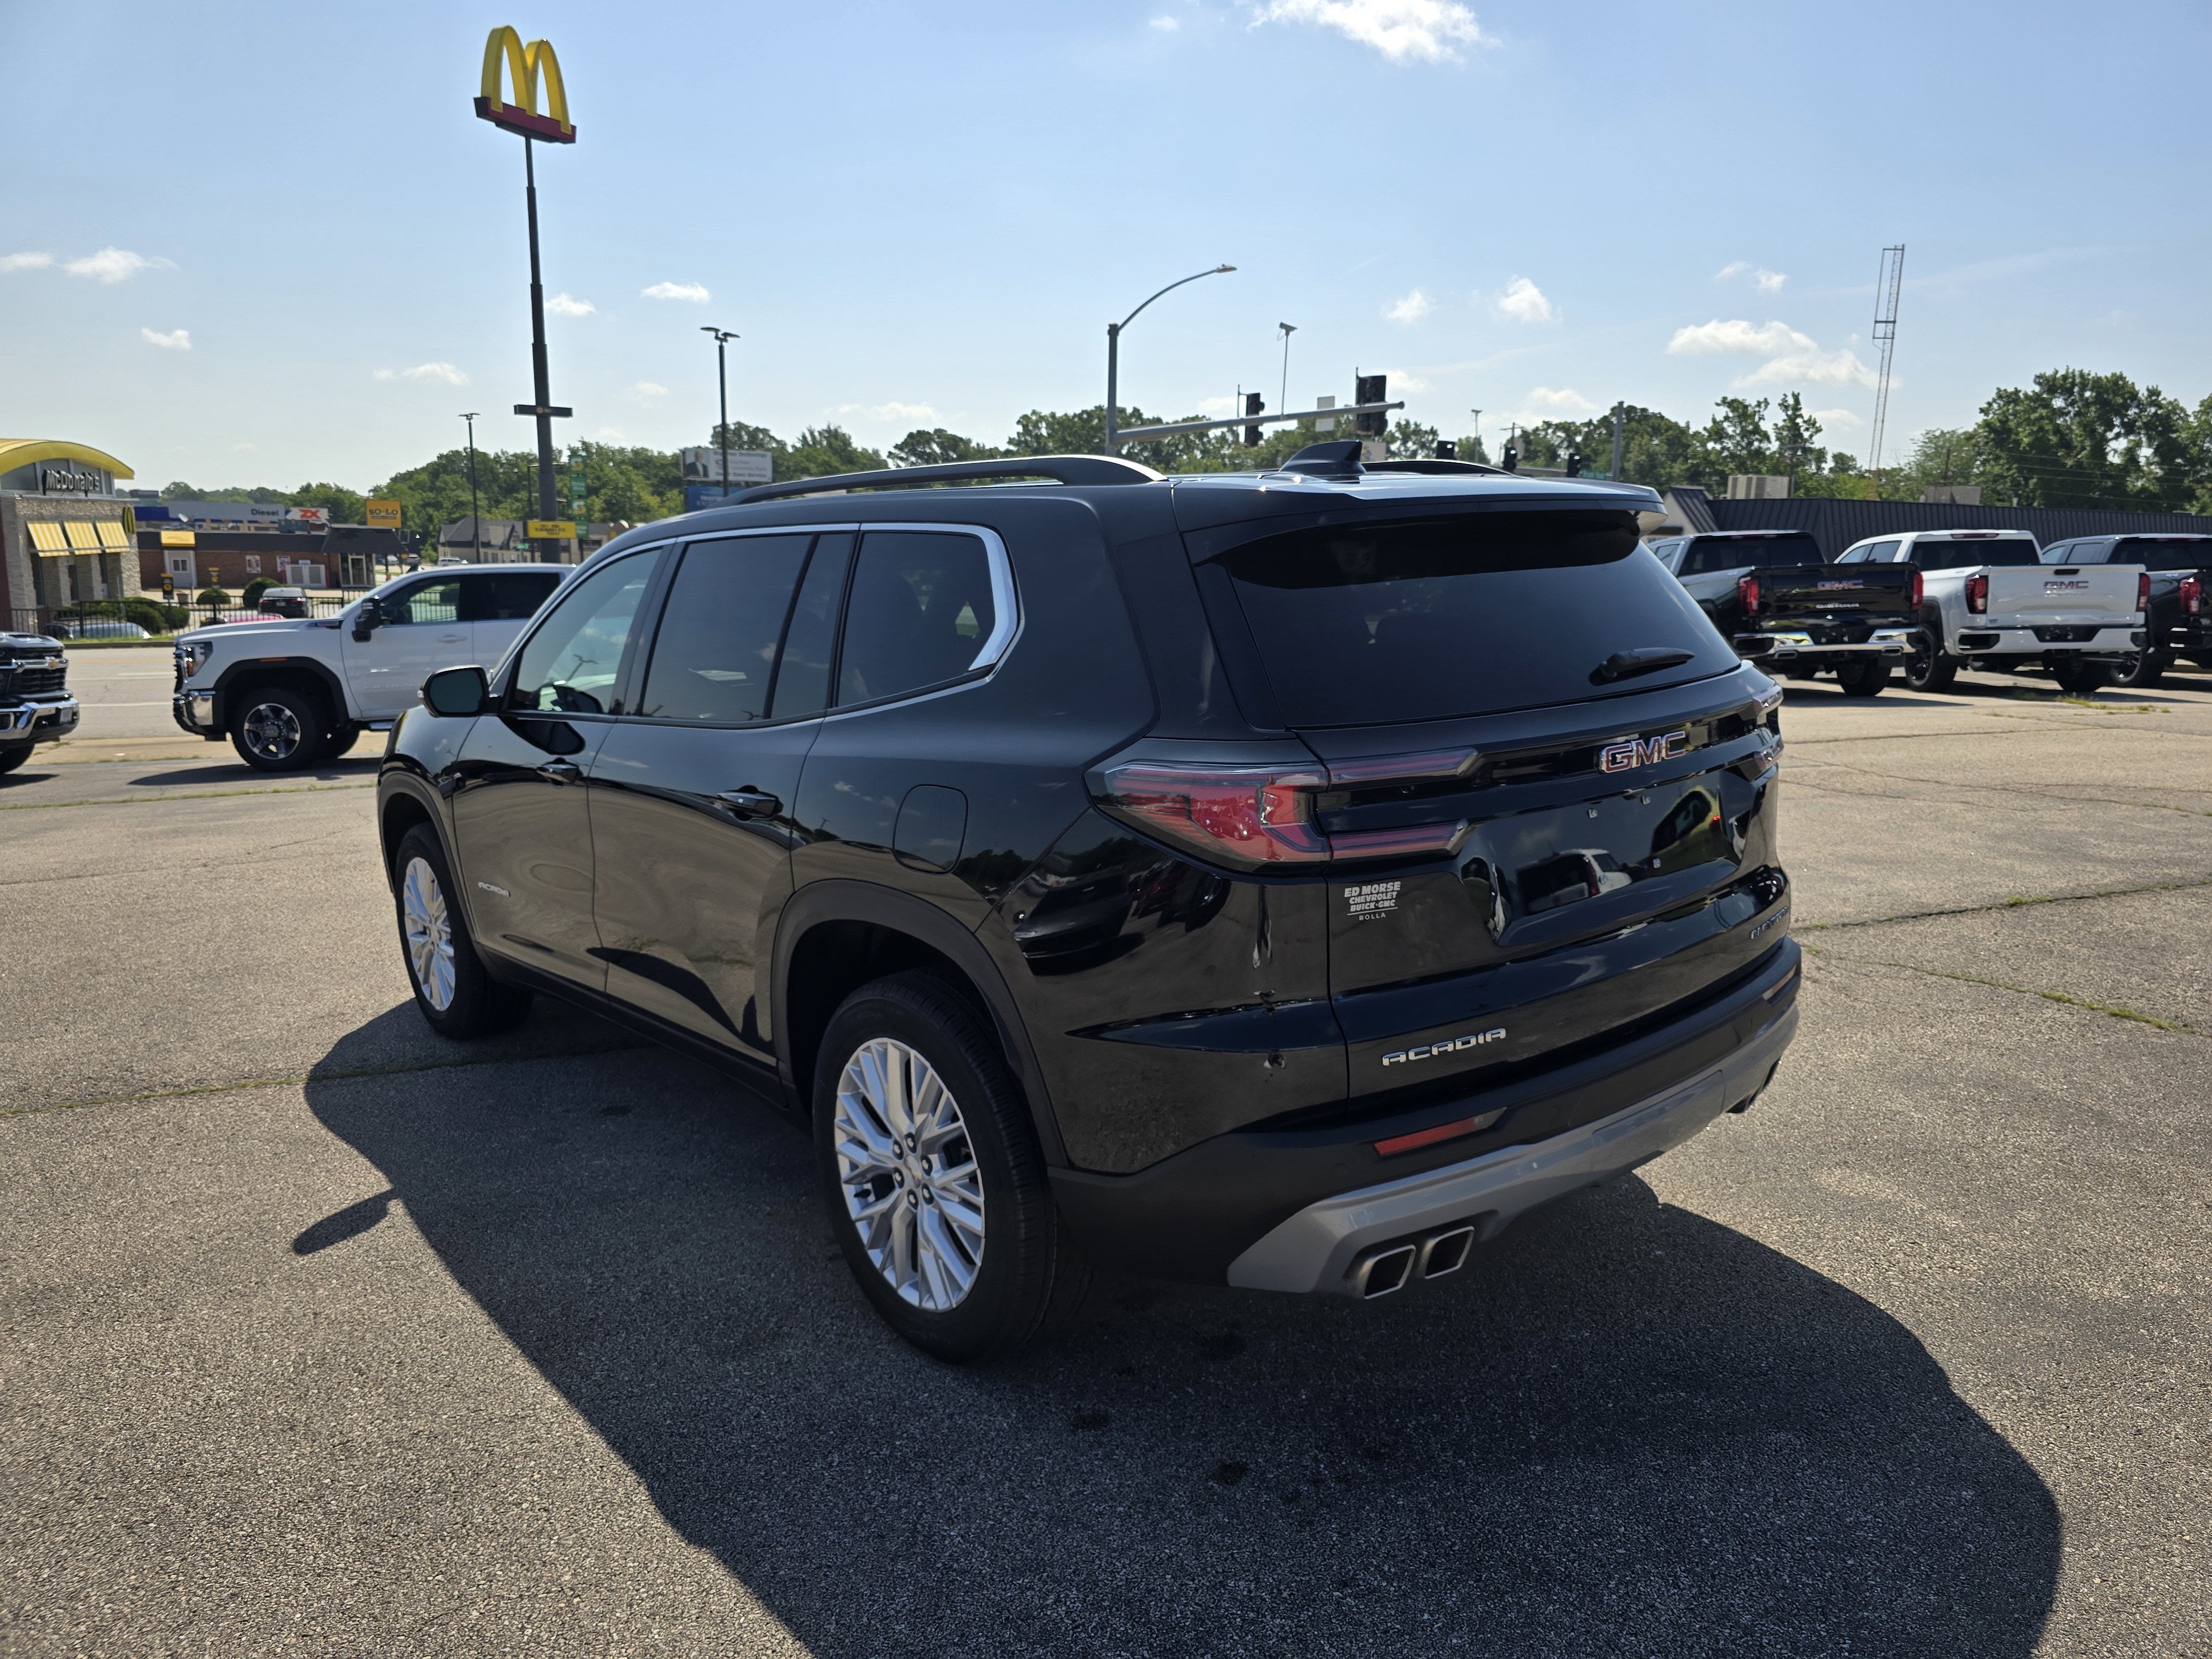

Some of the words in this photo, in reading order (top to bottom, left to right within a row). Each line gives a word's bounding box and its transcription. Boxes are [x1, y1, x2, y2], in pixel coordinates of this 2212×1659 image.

[43, 469, 100, 492] McDonald's
[251, 508, 279, 517] Diesel
[1817, 580, 1864, 591] GMC
[2044, 581, 2089, 589] GMC
[1601, 731, 1686, 774] GMC
[1344, 886, 1360, 897] ED
[1361, 881, 1401, 895] MORSE
[1349, 891, 1397, 904] CHEVROLET
[1359, 912, 1386, 921] ROLLA
[1382, 1028, 1506, 1066] ACADIA
